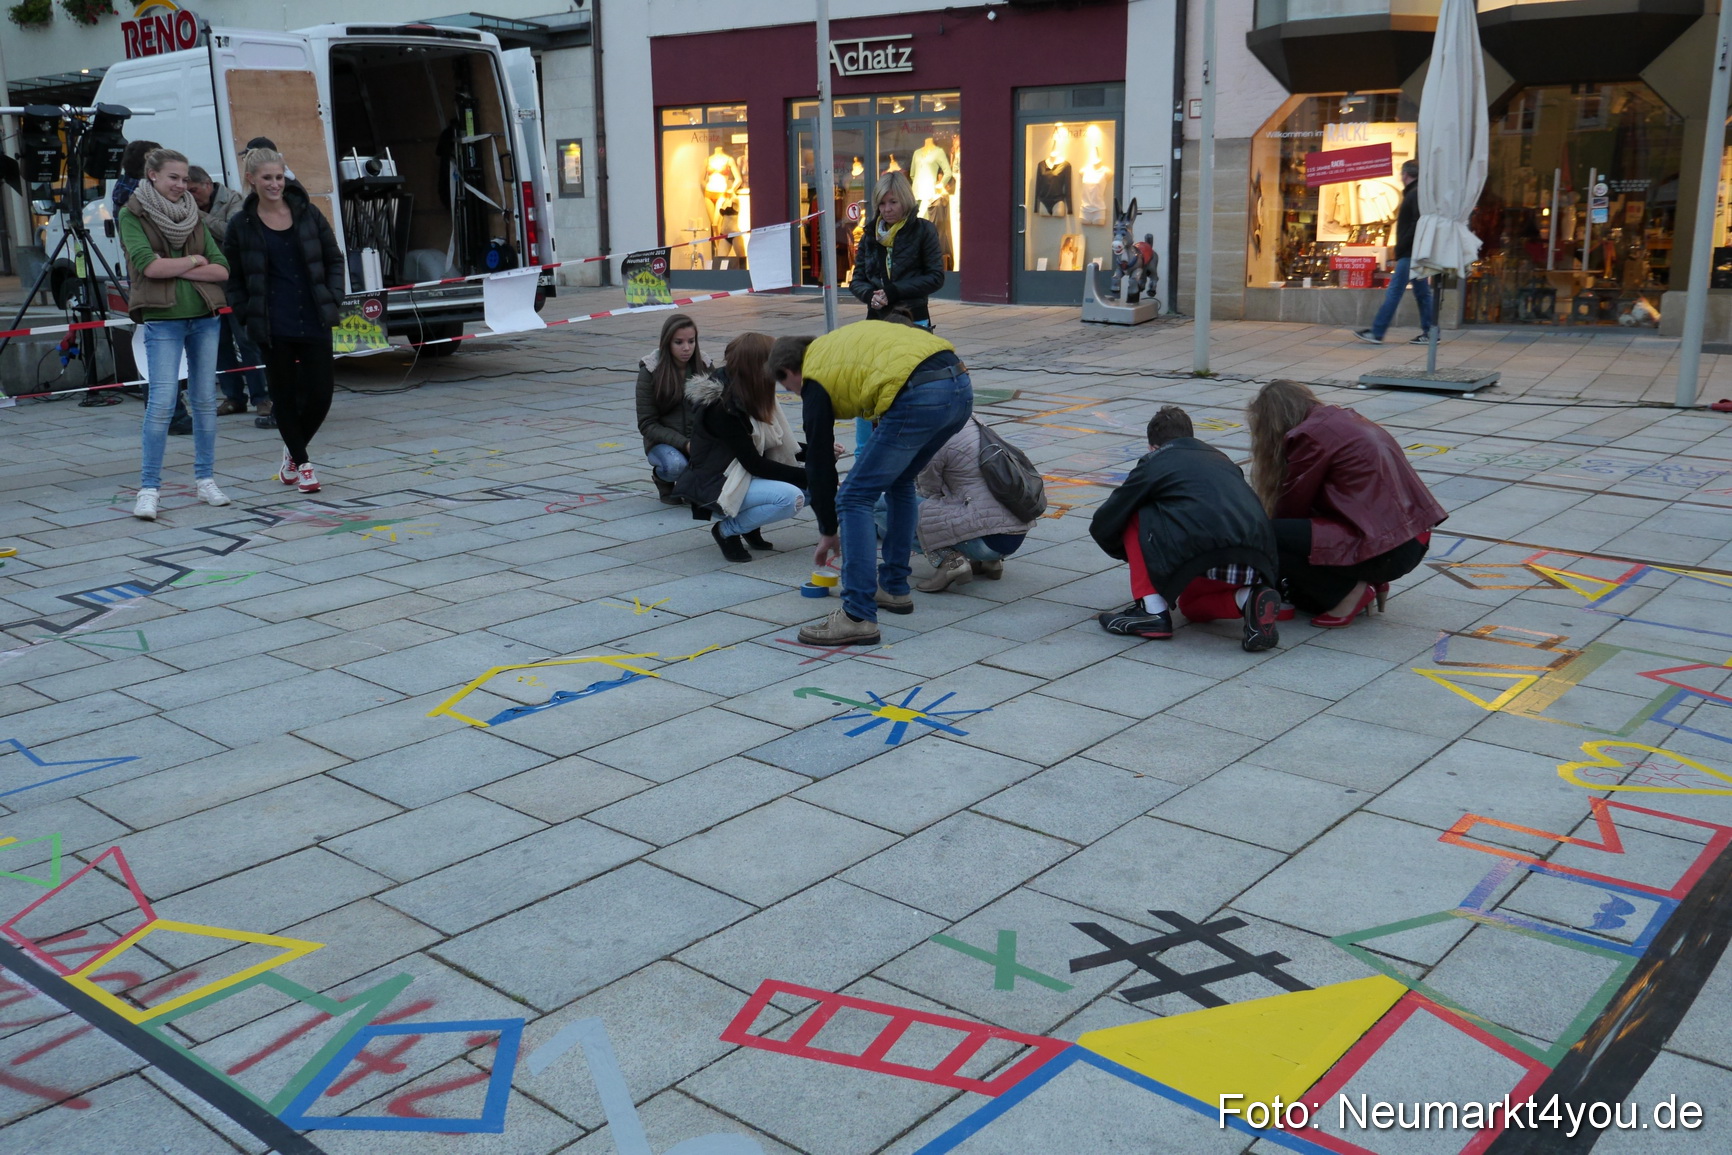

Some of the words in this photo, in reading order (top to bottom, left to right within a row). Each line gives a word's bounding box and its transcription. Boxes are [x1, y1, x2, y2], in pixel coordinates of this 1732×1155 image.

[121, 10, 197, 59] RENO
[829, 34, 913, 76] Achatz
[901, 120, 935, 134] Achatz
[1052, 125, 1088, 138] Ahatz
[1265, 130, 1314, 138] Willkommen
[1327, 121, 1369, 142] RACKL
[691, 131, 720, 143] Achatz
[653, 262, 665, 270] 28.9.
[365, 304, 380, 313] 28.9.
